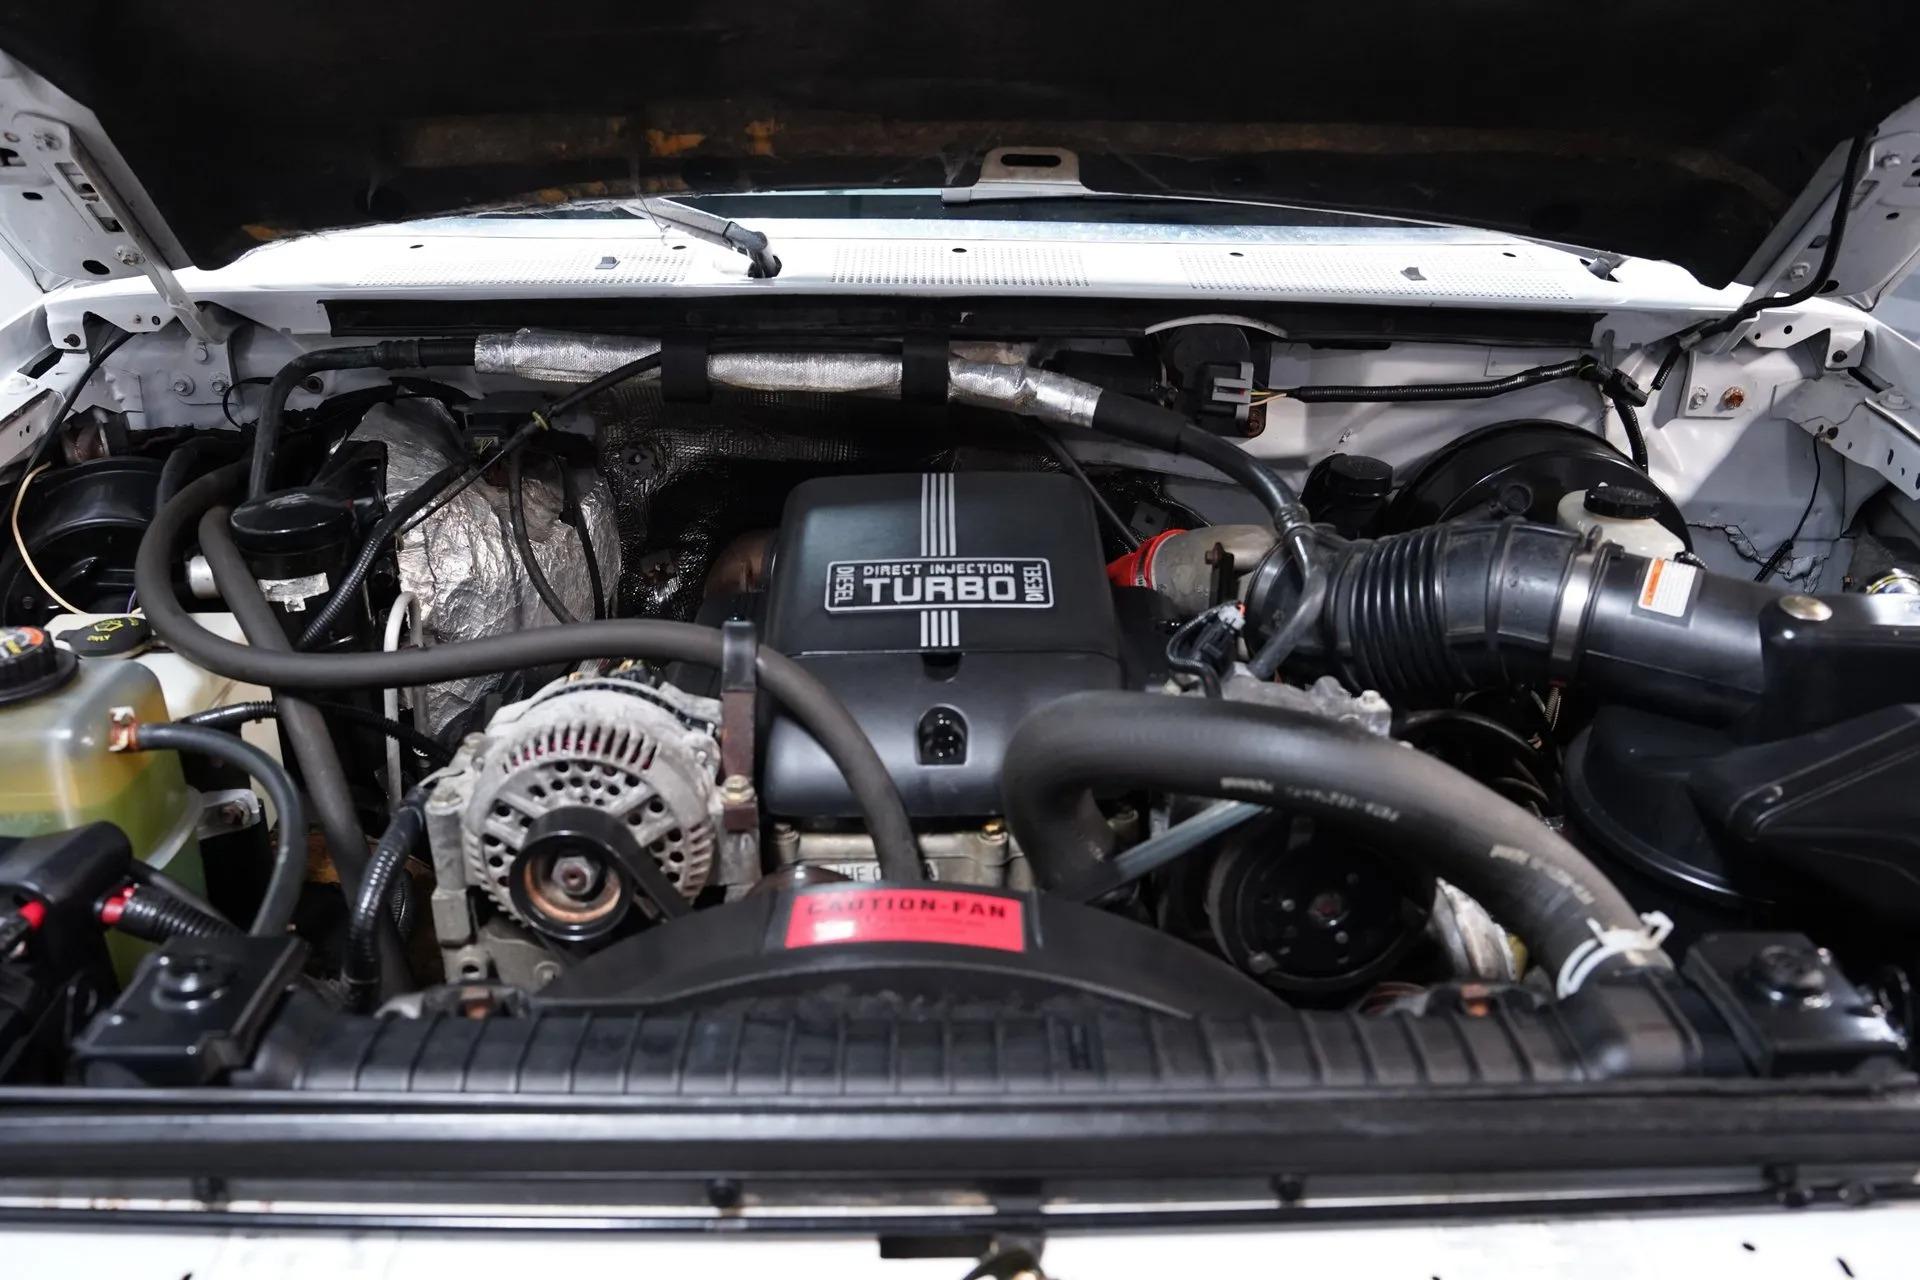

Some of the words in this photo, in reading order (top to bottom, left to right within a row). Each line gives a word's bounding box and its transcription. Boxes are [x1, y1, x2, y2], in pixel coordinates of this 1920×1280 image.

[835, 566, 855, 604] DIESEL
[863, 564, 922, 576] DIRECT
[930, 563, 1014, 575] INJECTION
[1023, 564, 1044, 602] DIESEL
[863, 576, 1017, 603] TURBO
